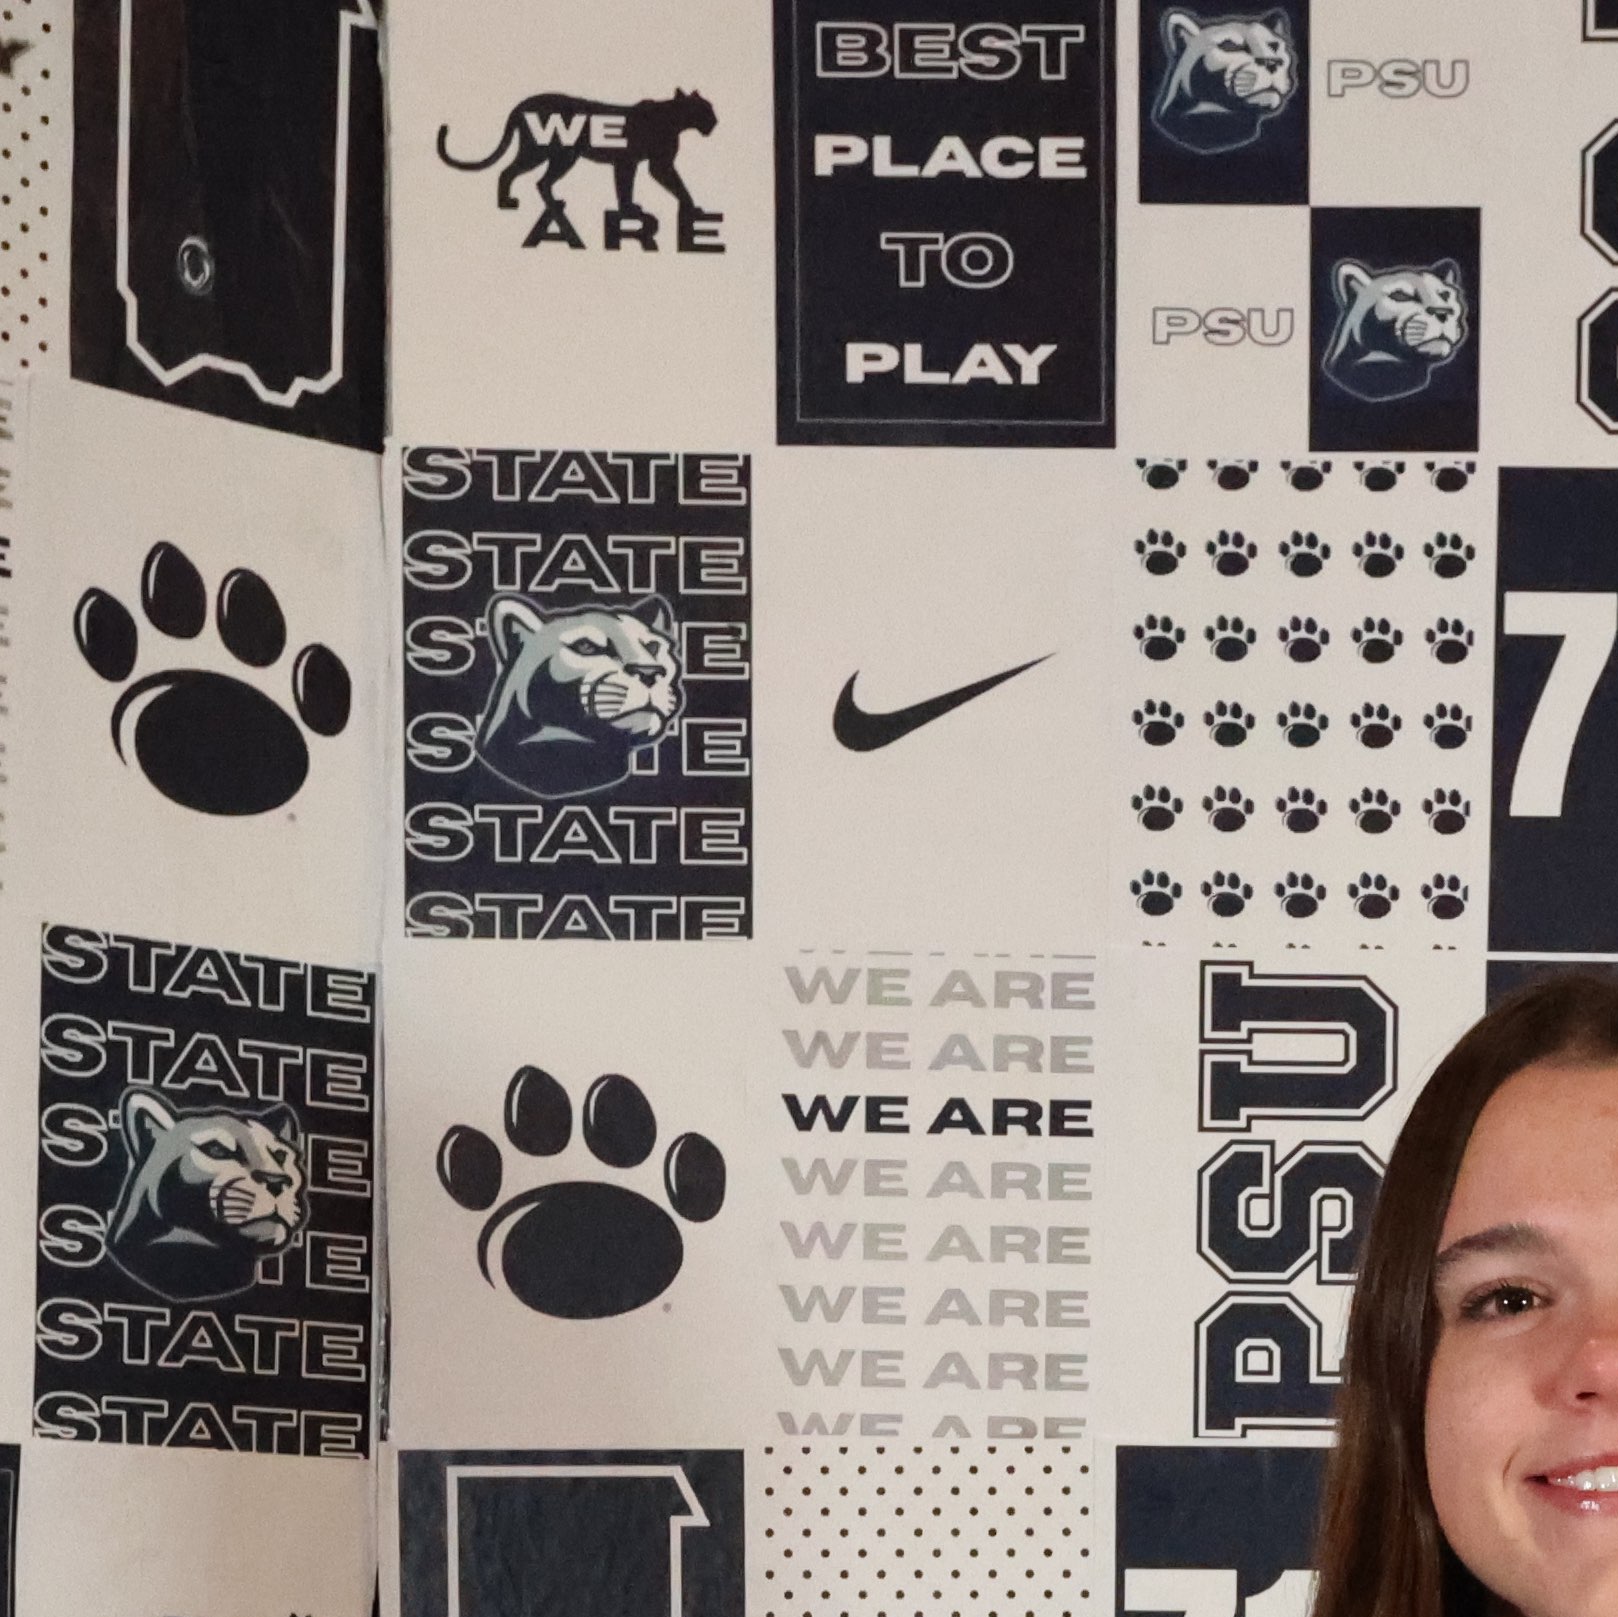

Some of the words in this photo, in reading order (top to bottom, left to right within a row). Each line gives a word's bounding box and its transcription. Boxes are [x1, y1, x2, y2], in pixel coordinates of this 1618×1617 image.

[815, 22, 1085, 81] BEST
[1327, 59, 1470, 99] PSU
[524, 114, 628, 148] WE
[814, 134, 1088, 180] PLACE
[522, 206, 727, 254] ARE
[880, 231, 1014, 289] TO
[1152, 307, 1295, 346] PSU
[845, 342, 1058, 385] PLAY
[403, 445, 748, 505] STATE
[403, 530, 747, 595] STATE
[405, 801, 748, 865] STATE
[405, 891, 748, 941] STATE
[42, 923, 370, 1022] STATE
[783, 967, 913, 1008] WE
[929, 970, 1096, 1011] ARE
[41, 1012, 369, 1112] STATE
[782, 1029, 912, 1071] WE
[928, 1033, 1095, 1074] ARE
[781, 1093, 911, 1134] WE
[926, 1097, 1095, 1138] ARE
[780, 1156, 909, 1198] WE
[925, 1161, 1093, 1201] ARE
[1193, 960, 1399, 1439] PSU
[780, 1221, 909, 1261] WE
[925, 1224, 1092, 1265] ARE
[779, 1284, 907, 1325] WE
[924, 1288, 1091, 1328] ARE
[36, 1297, 366, 1382] STATE
[777, 1348, 906, 1389] WE
[922, 1351, 1090, 1391] ARE
[33, 1390, 364, 1459] STATE
